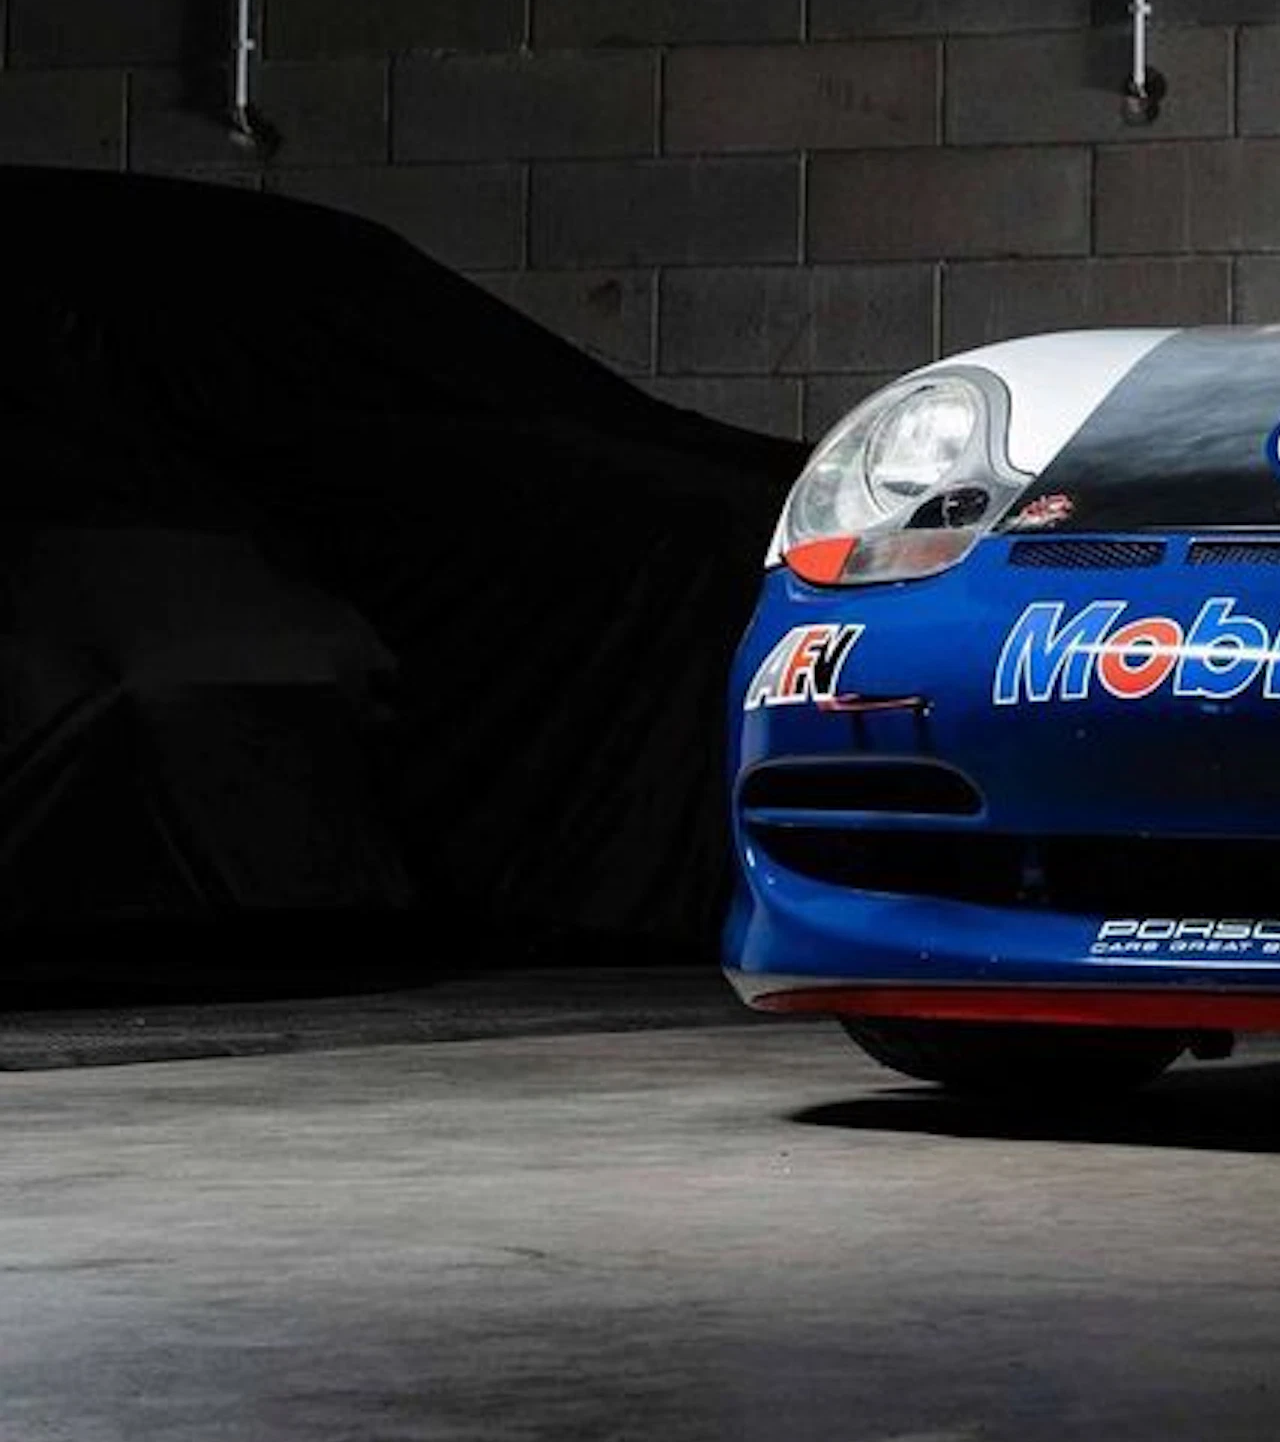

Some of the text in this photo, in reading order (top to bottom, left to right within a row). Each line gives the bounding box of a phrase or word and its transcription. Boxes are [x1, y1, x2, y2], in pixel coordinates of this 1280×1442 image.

[743, 623, 866, 711] AFN
[1090, 941, 1160, 955] CARS
[1169, 939, 1252, 954] GREAT
